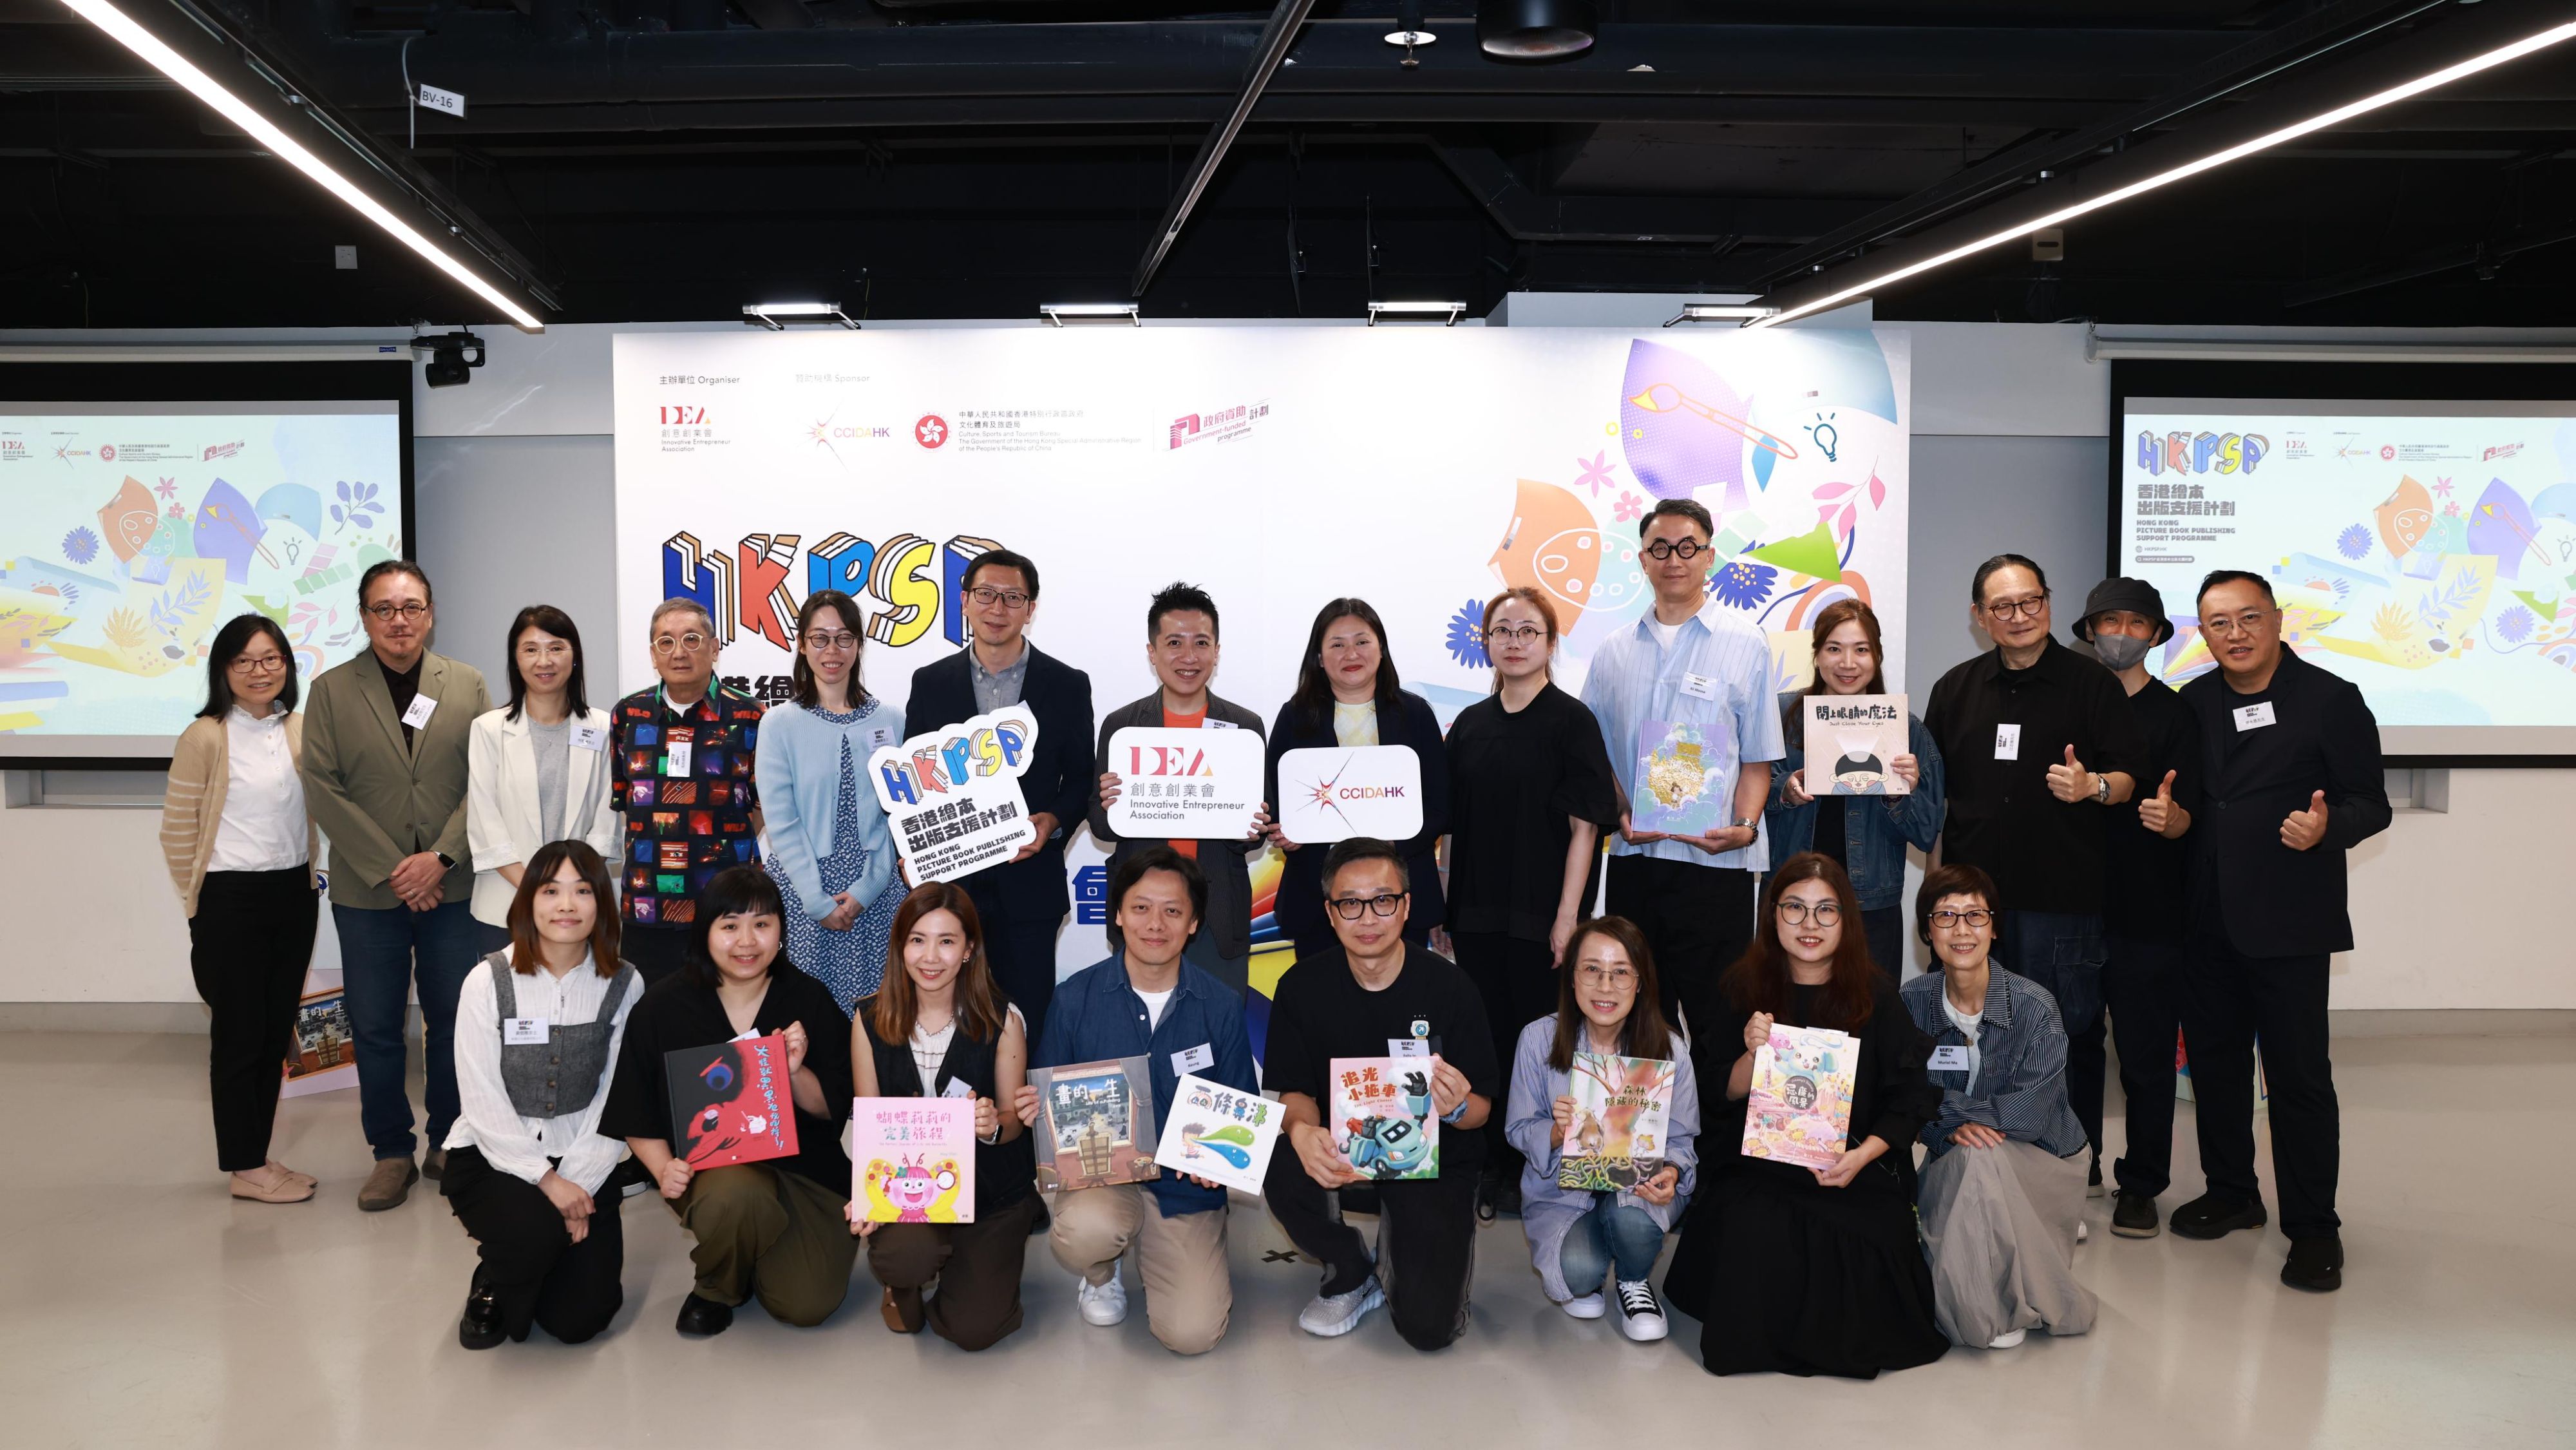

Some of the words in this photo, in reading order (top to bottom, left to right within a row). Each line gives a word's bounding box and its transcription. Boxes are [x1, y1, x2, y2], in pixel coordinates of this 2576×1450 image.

[422, 90, 453, 108] BV-16
[659, 376, 696, 385] 主辦單位
[698, 376, 740, 386] Organiser
[835, 374, 870, 384] Sponsor
[1204, 405, 1246, 428] 政府資助
[1249, 405, 1269, 420] 計劃
[833, 427, 890, 438] CCIDAHK
[1184, 420, 1246, 444] Government-funded
[1218, 426, 1252, 443] programme
[2138, 430, 2270, 477] HKPSP
[2137, 484, 2204, 499] 香港繪本
[2137, 501, 2235, 517] 出版支援計劃
[1816, 704, 1897, 721] 閉上眼睛的魔法
[881, 720, 1028, 805] HKPSP
[1130, 783, 1215, 797] 創意創業會
[1340, 786, 1405, 800] CCIDAHK
[1130, 799, 1179, 810] Innovative
[1183, 799, 1245, 812] Entrepreneur
[901, 797, 977, 835] 香港繪本
[1130, 810, 1184, 820] Association
[907, 801, 1018, 854] 出版支援計劃
[914, 852, 937, 864] HONG
[938, 844, 961, 857] KONG
[917, 856, 952, 873] PICTURE
[954, 848, 976, 862] BOOK
[977, 830, 1026, 852] PUBLISHING
[920, 863, 956, 881] SUPPORT
[958, 845, 1008, 866] PROGRAMME
[1341, 1067, 1379, 1088] 追光
[1056, 1078, 1121, 1105] 畫的一生
[1349, 1083, 1397, 1101] 小拖車
[1624, 1085, 1647, 1096] 森林
[1605, 1096, 1662, 1112] 隱藏的秘密
[876, 1111, 952, 1125] 蝴蝶莉莉的
[884, 1126, 943, 1140] 完美旅程
